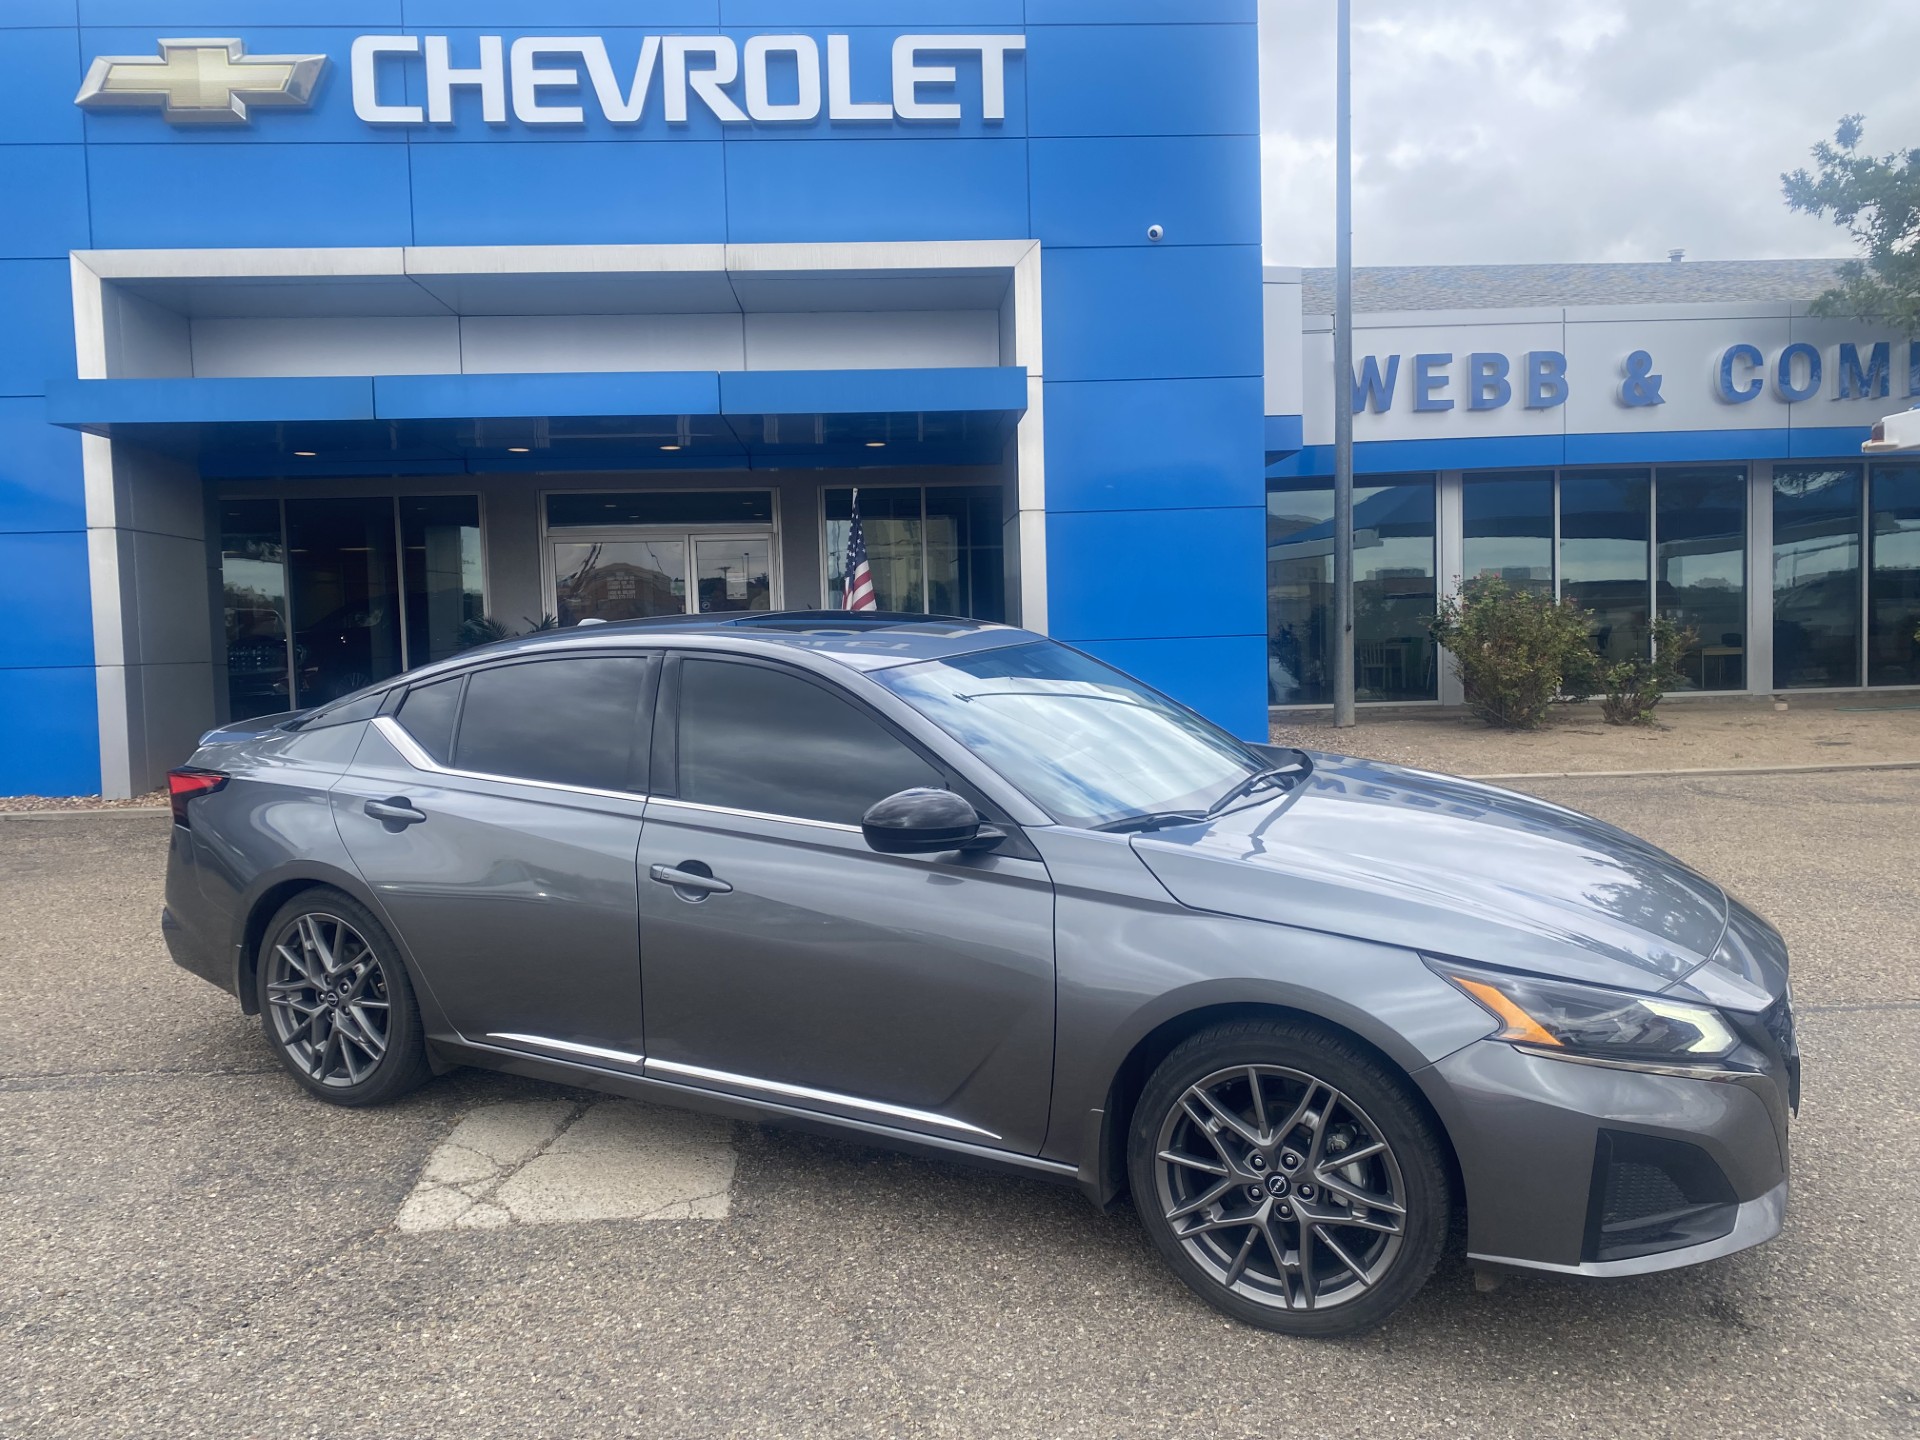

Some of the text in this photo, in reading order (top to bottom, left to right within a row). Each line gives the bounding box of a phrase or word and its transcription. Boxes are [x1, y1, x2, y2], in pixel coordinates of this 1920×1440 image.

[351, 34, 1026, 123] CHEVROLET
[1352, 350, 1569, 413] WEBB
[1618, 350, 1666, 406] &
